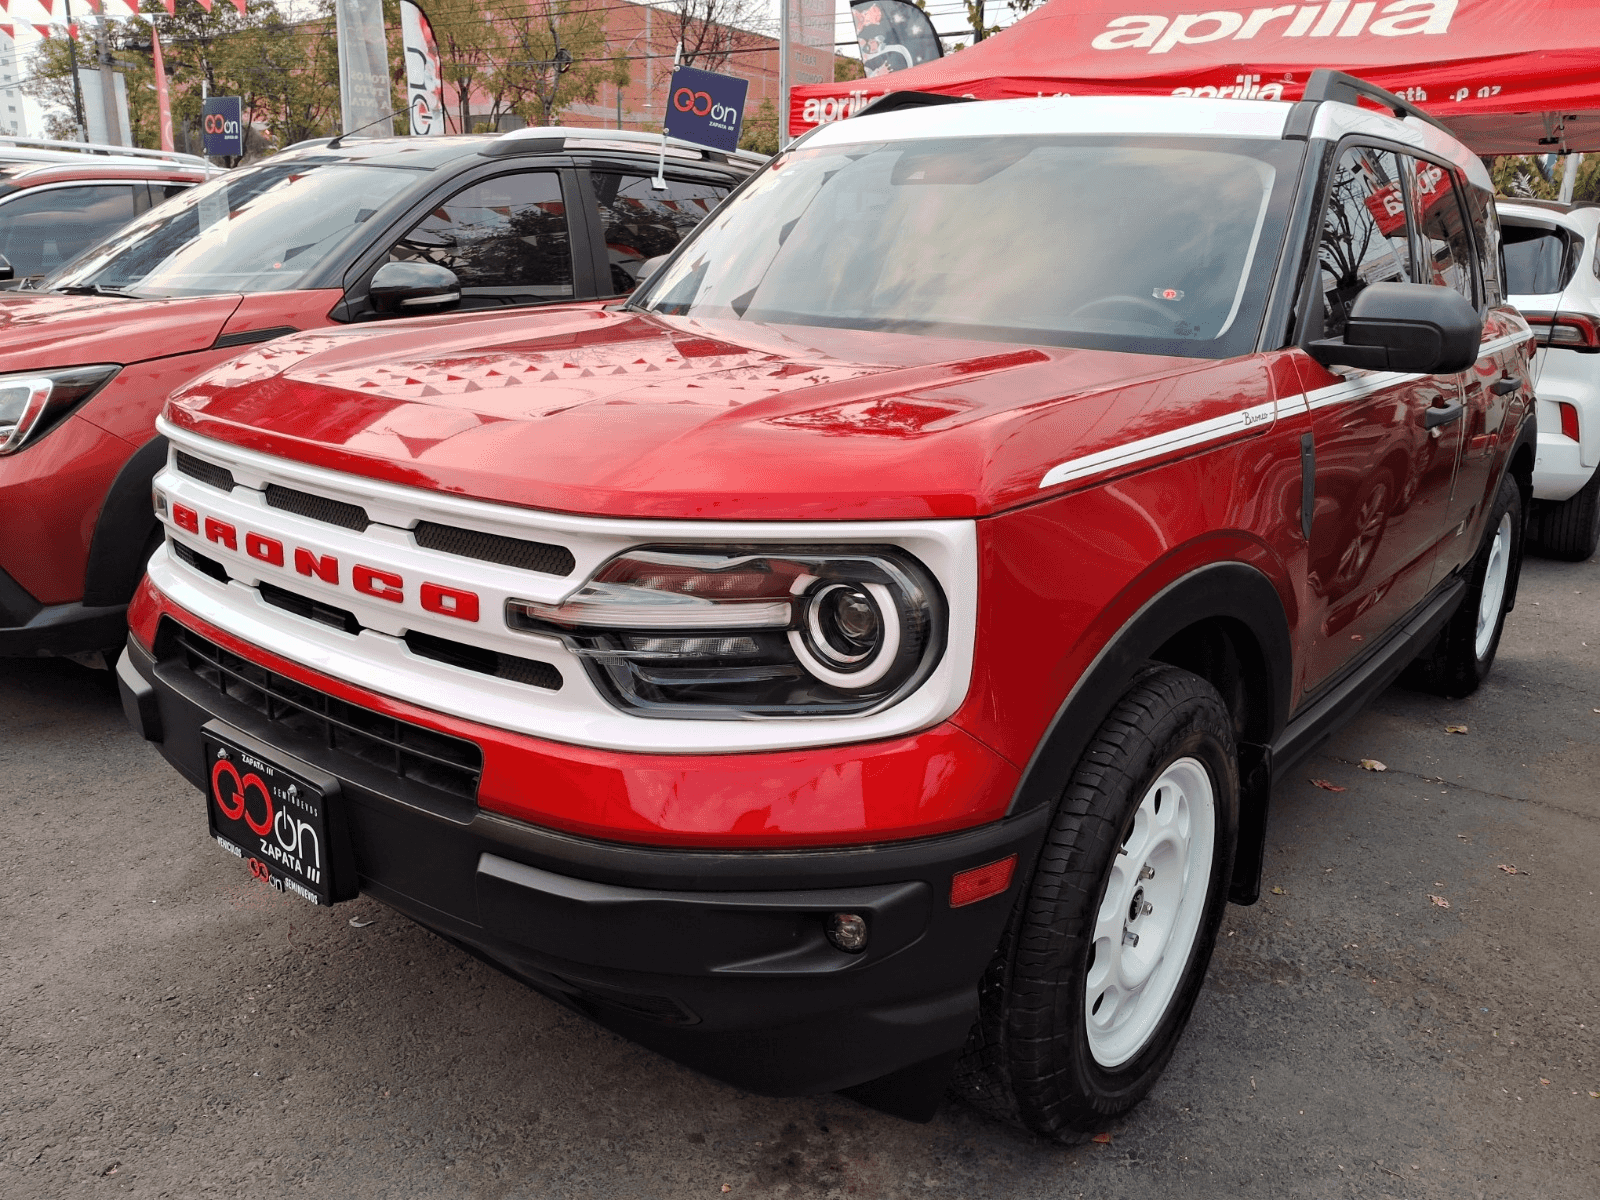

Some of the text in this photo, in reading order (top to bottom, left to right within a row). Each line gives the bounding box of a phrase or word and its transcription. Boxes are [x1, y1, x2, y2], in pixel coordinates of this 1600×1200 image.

[1091, 0, 1460, 54] aprilia
[803, 90, 880, 125] aprili
[1242, 411, 1268, 425] Bronco
[172, 501, 480, 622] BRONCO
[241, 754, 265, 772] ZAPATA
[259, 838, 321, 885] ZAPATA III
